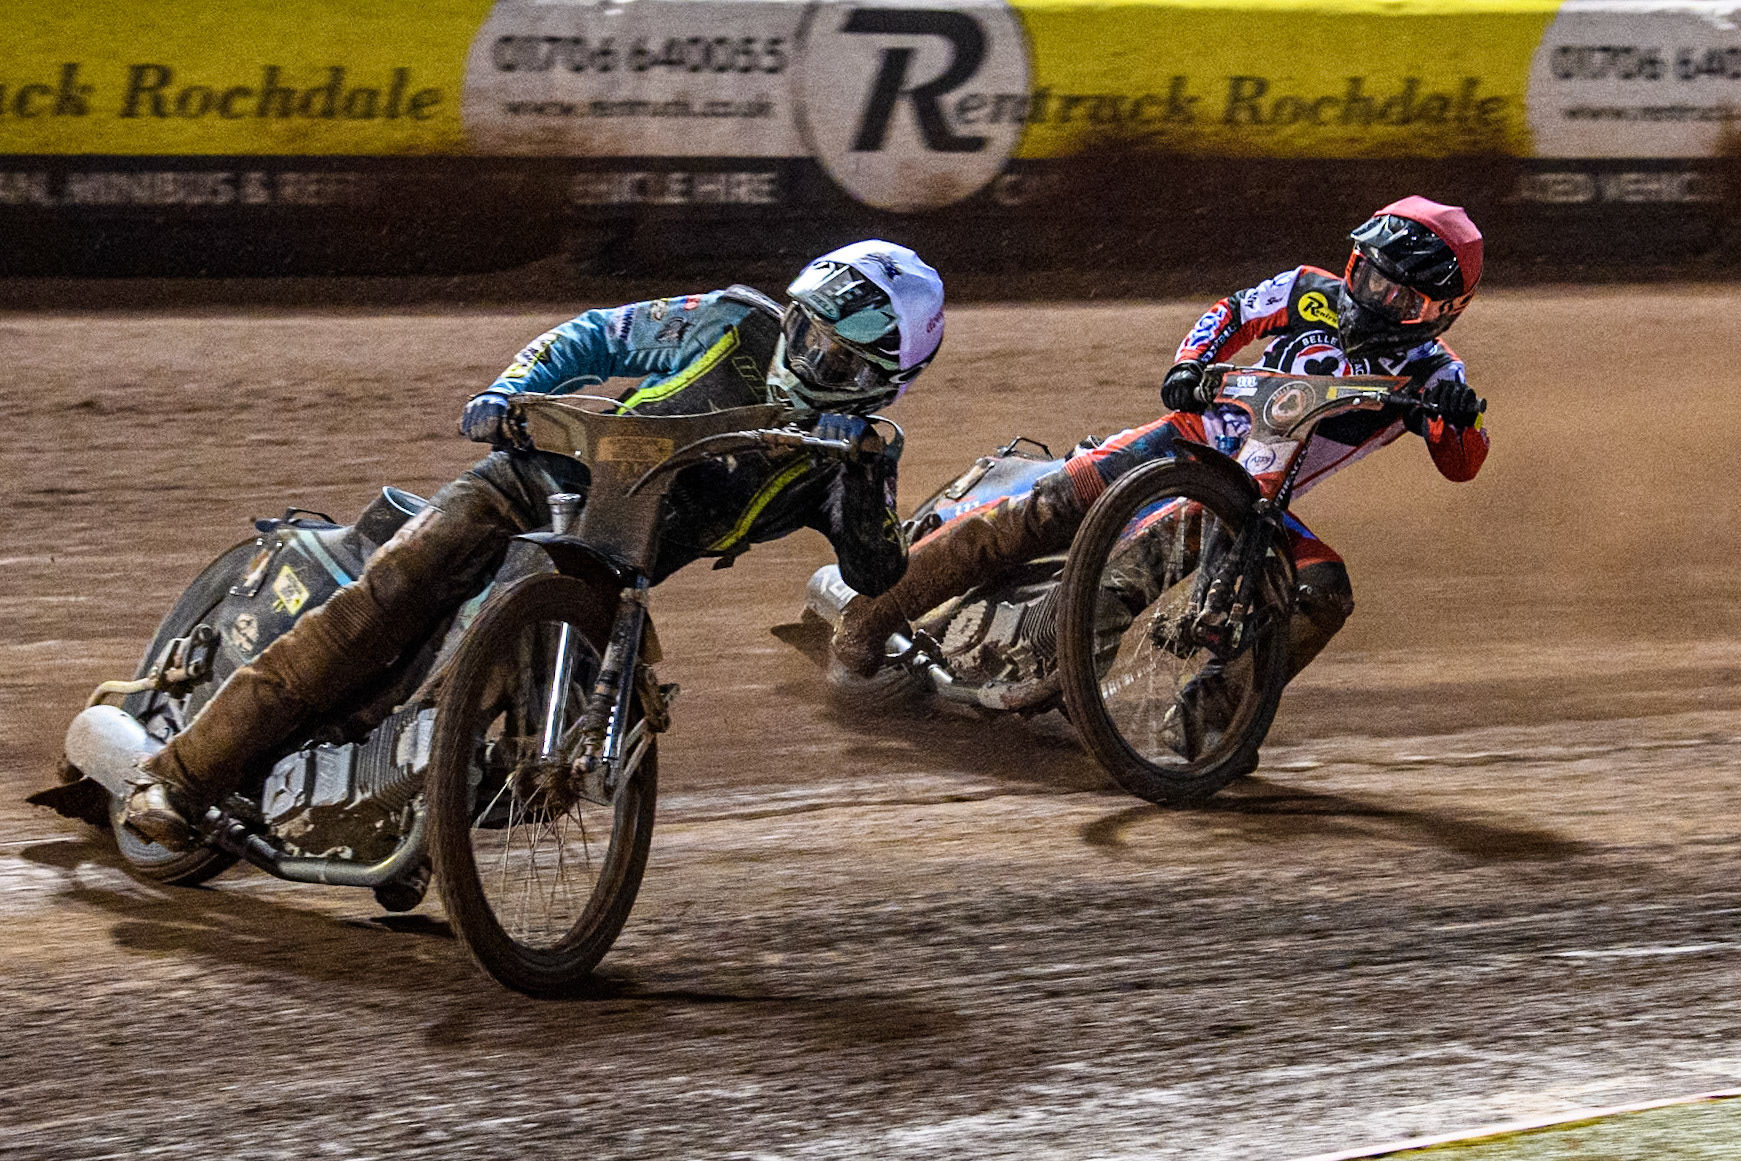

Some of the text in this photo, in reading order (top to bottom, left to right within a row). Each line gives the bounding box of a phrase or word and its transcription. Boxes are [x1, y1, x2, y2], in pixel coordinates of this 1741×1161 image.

[0, 62, 444, 120] ck Rochdale
[1222, 75, 1507, 127] Rochdale
[1302, 334, 1338, 346] BELLE
